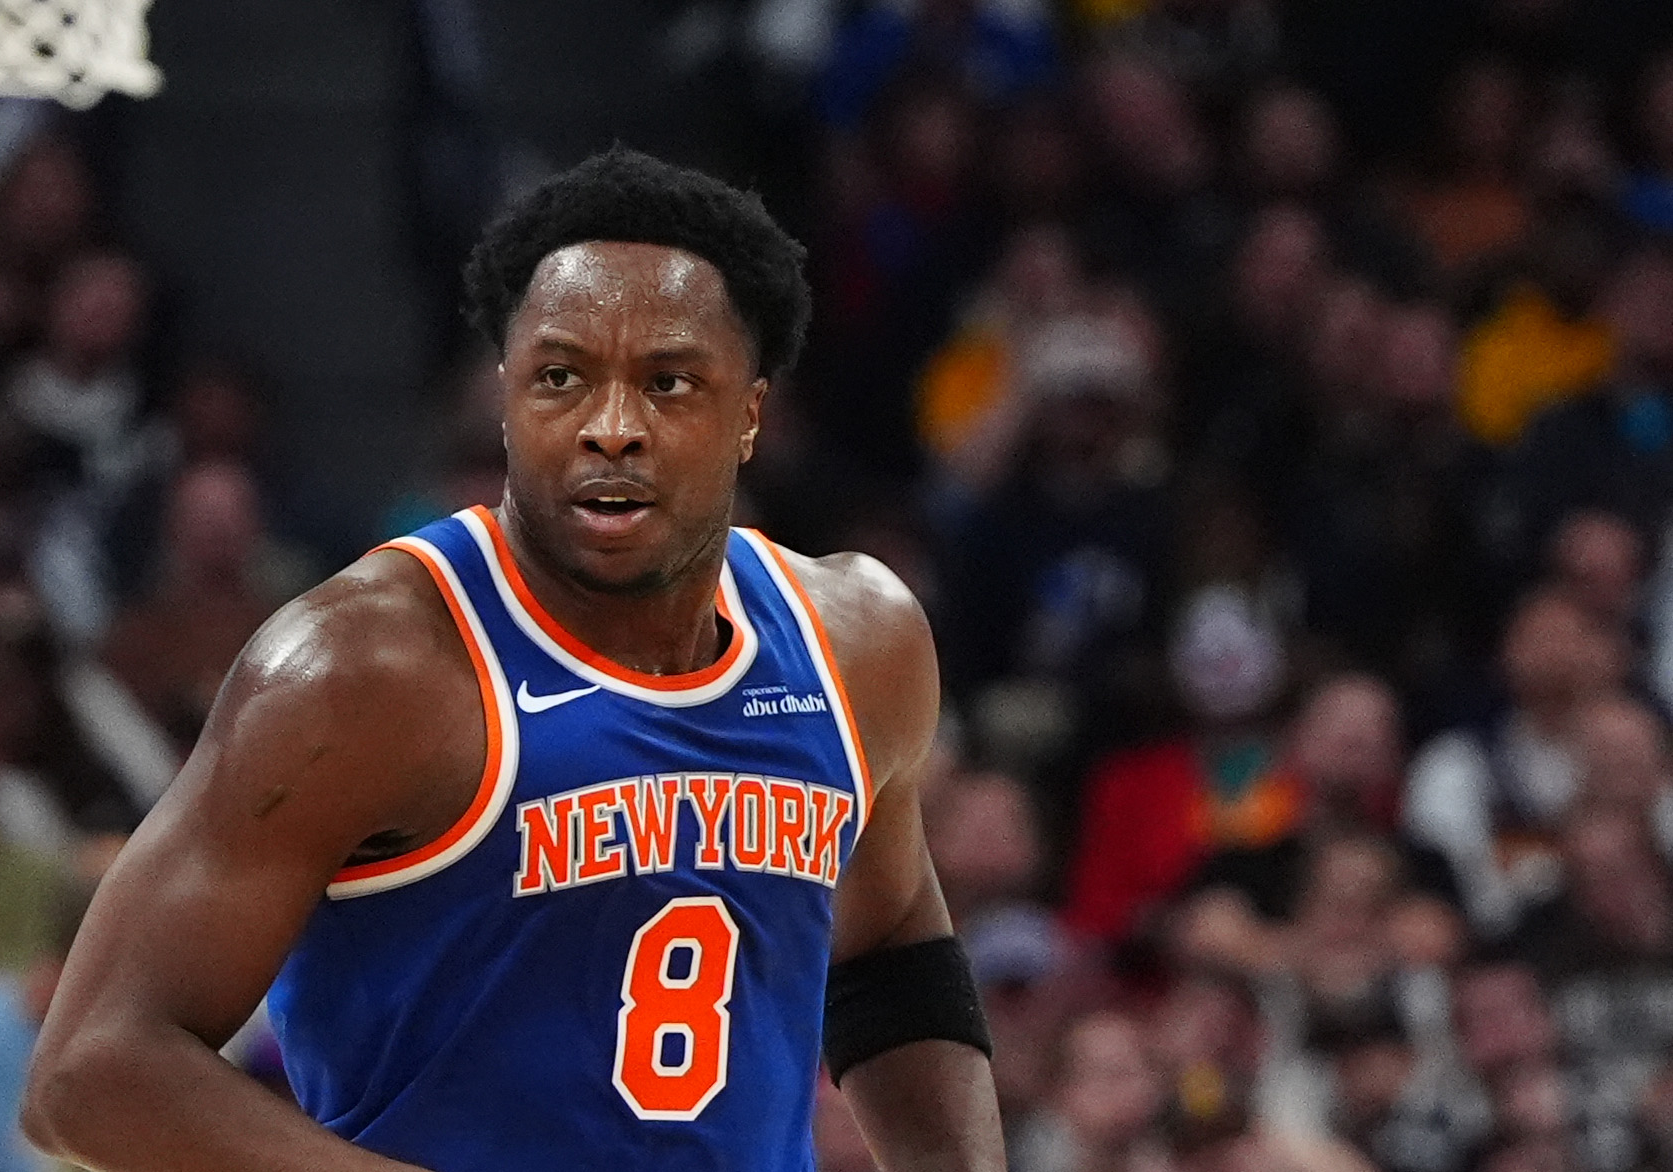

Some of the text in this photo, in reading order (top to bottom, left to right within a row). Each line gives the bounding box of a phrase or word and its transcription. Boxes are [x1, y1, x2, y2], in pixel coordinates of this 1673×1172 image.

[743, 693, 827, 717] abu dhabi
[512, 772, 853, 898] NEW YORK
[612, 896, 740, 1121] 8
